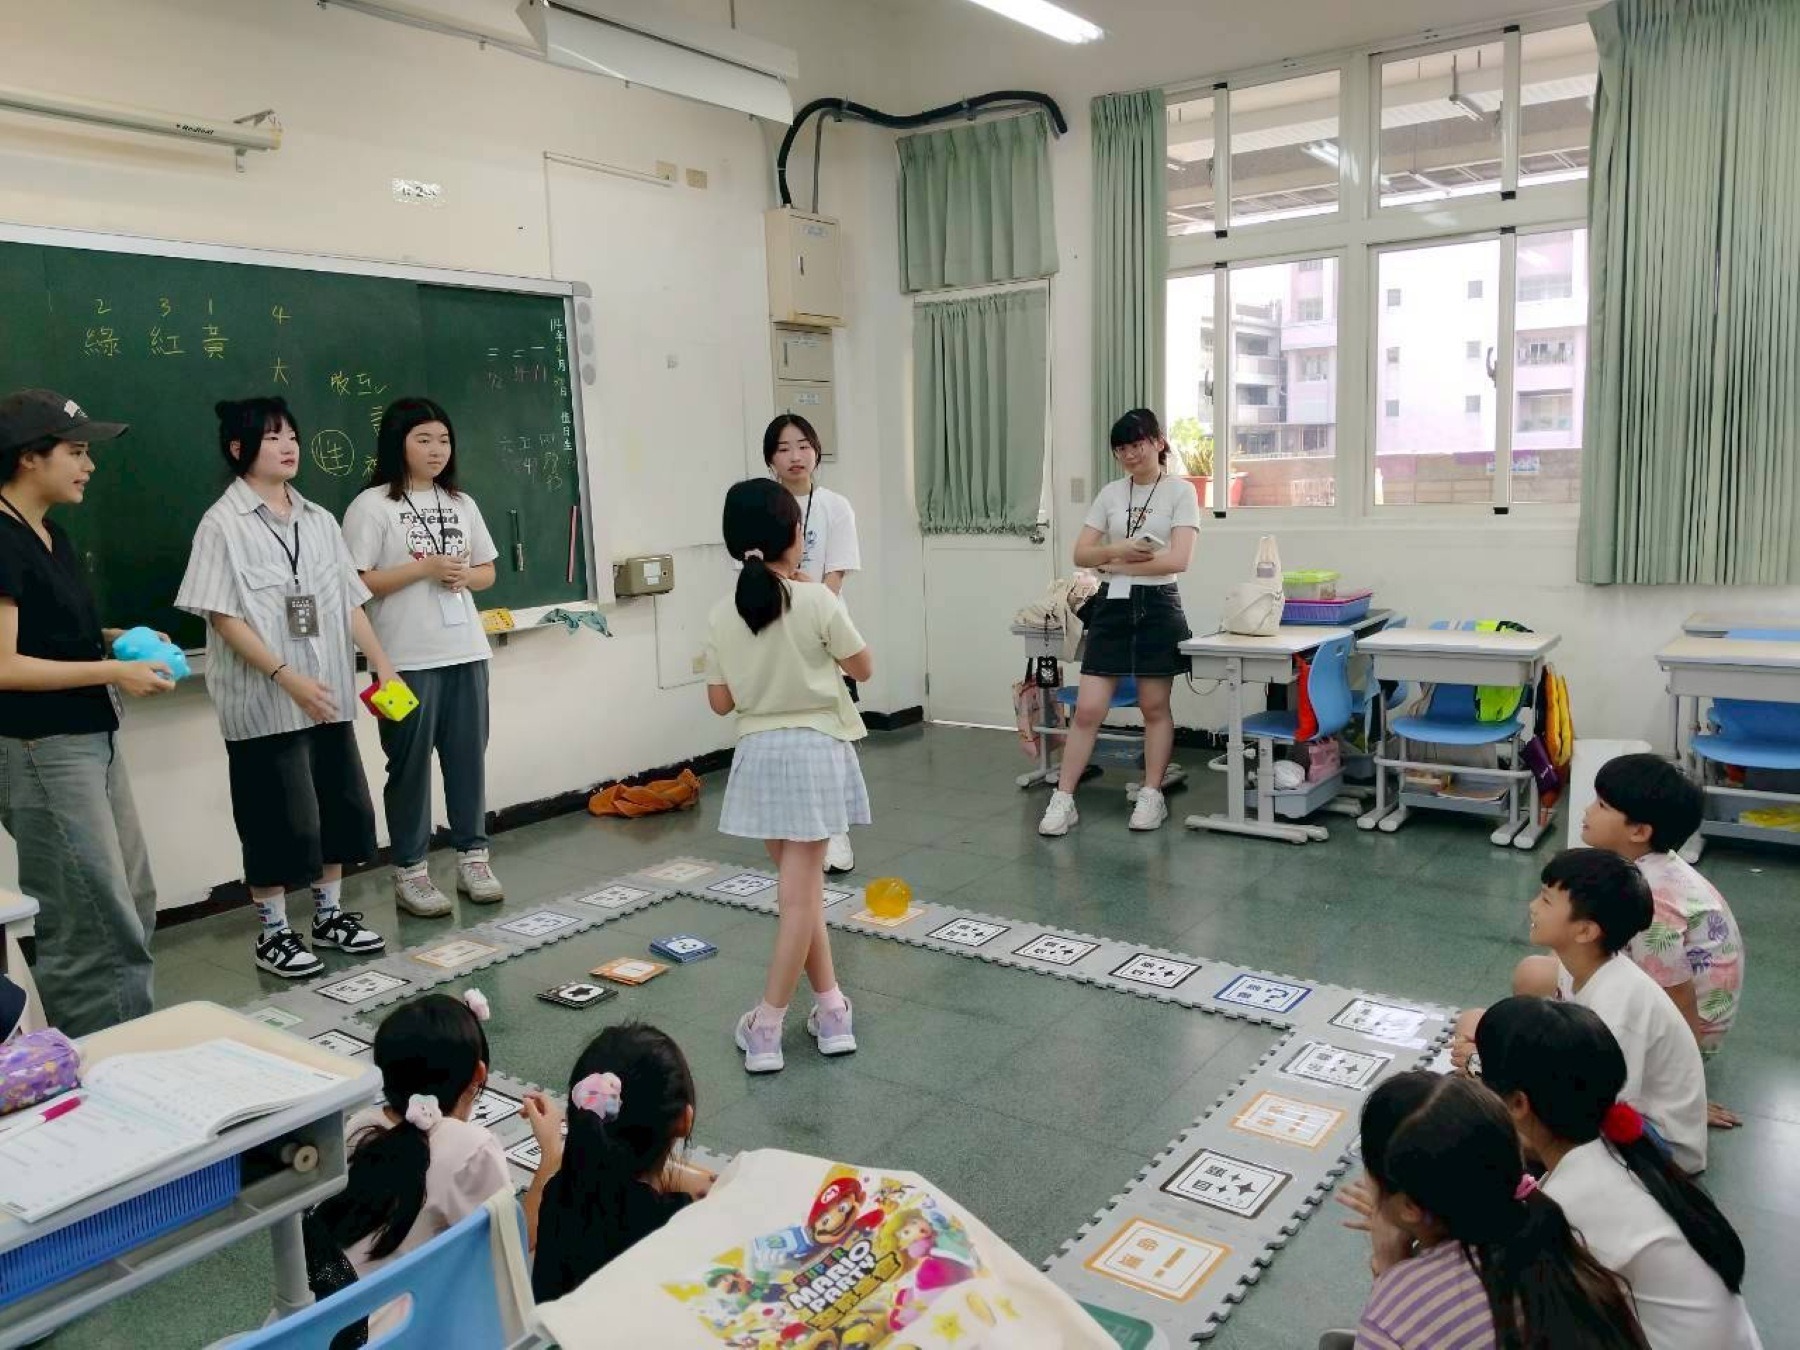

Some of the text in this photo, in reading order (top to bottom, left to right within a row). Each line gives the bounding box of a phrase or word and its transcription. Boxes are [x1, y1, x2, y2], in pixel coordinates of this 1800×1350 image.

[95, 298, 112, 314] 2
[159, 297, 171, 317] 3
[207, 298, 213, 316] 1
[271, 305, 293, 325] 4
[150, 325, 187, 356] 紅
[202, 324, 230, 359] 黃
[788, 1239, 872, 1310] MARIO
[808, 1253, 876, 1314] PARTY
